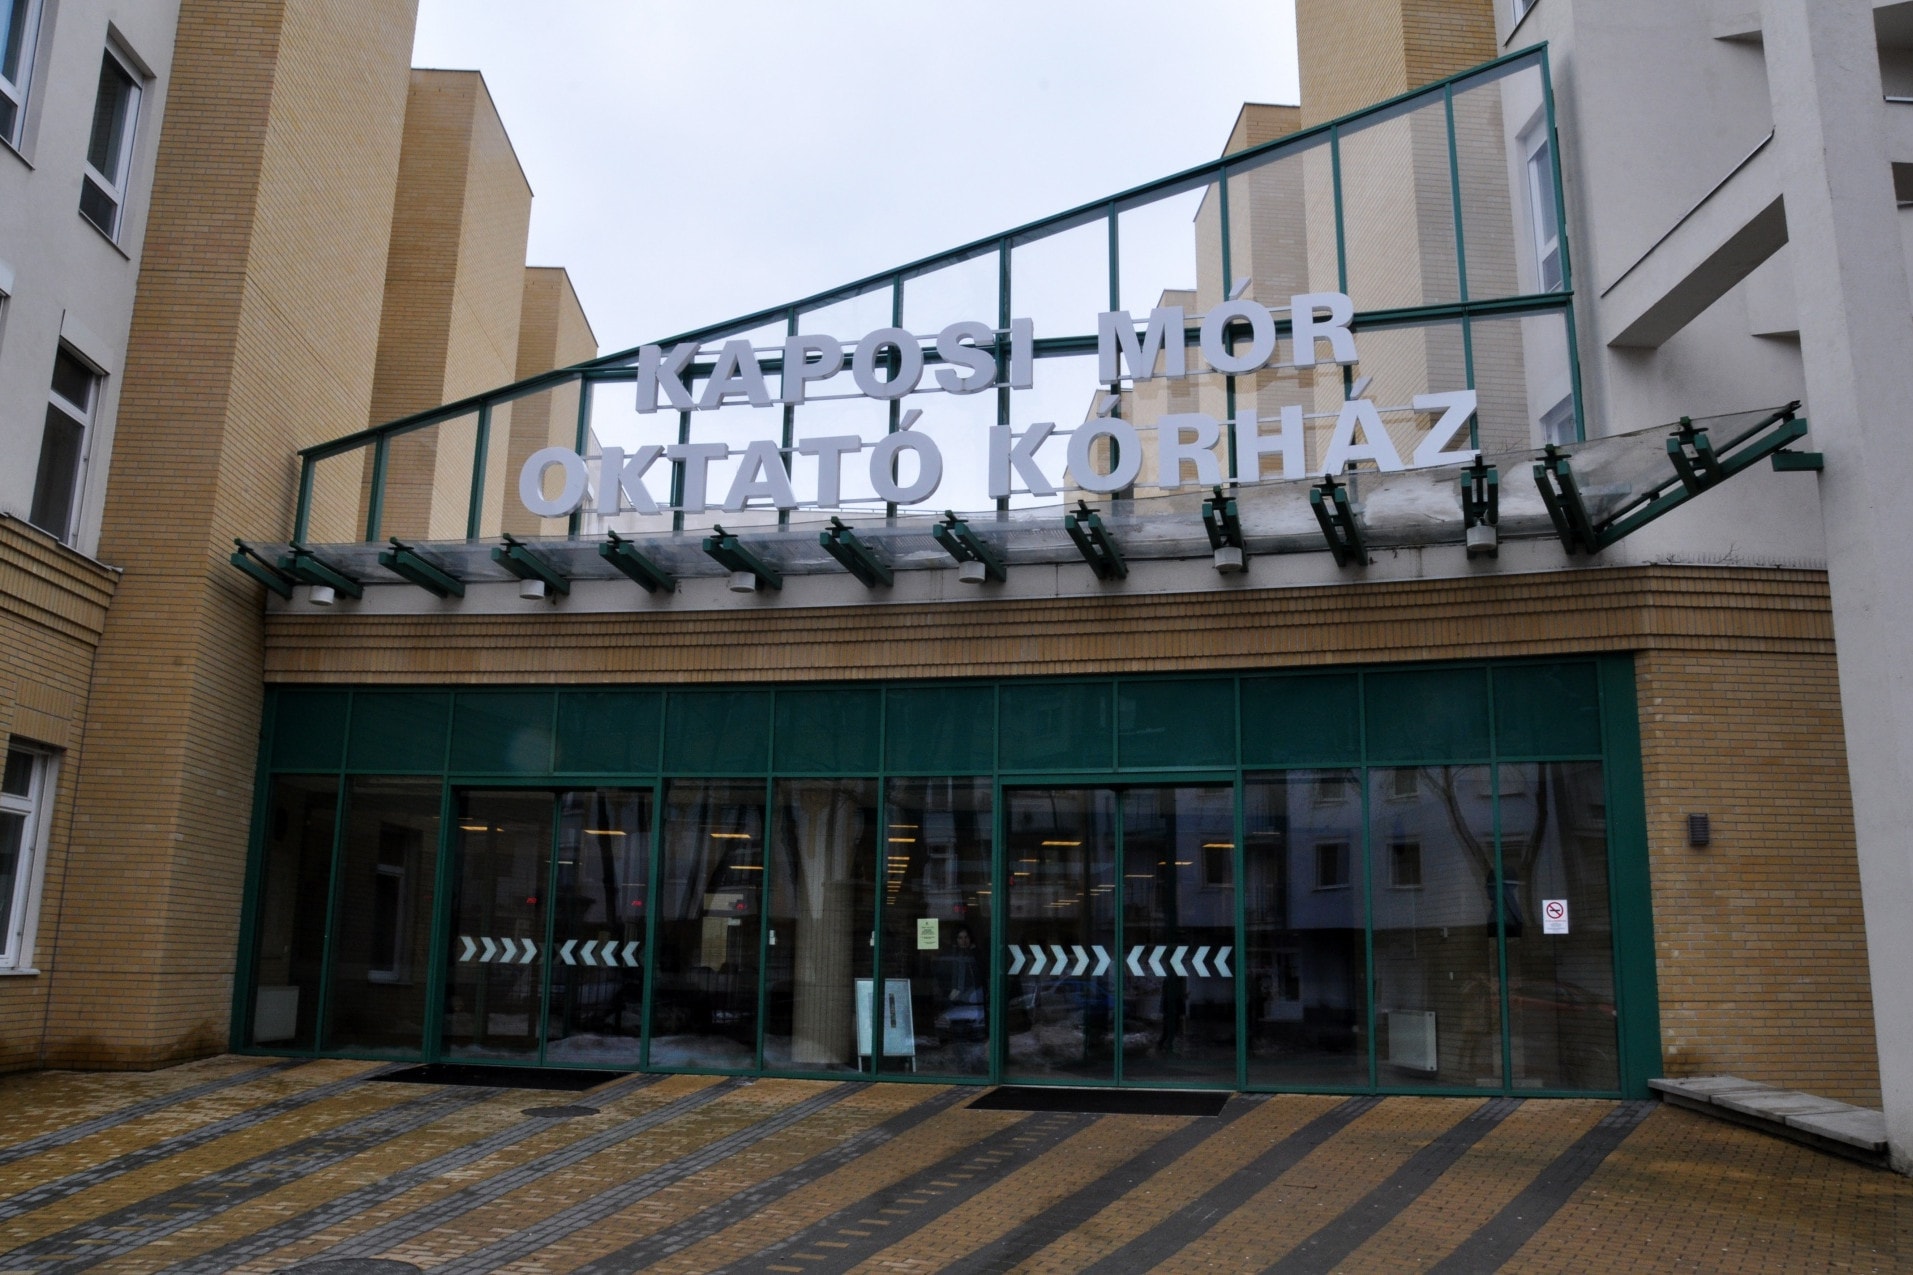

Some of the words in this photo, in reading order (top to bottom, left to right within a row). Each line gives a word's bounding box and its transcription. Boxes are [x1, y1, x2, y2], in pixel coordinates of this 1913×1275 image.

[635, 317, 1034, 414] KAPOSI
[1098, 277, 1359, 385] MÓR
[519, 408, 943, 518] OKTATÓ
[988, 376, 1480, 499] KÓRHÁZ
